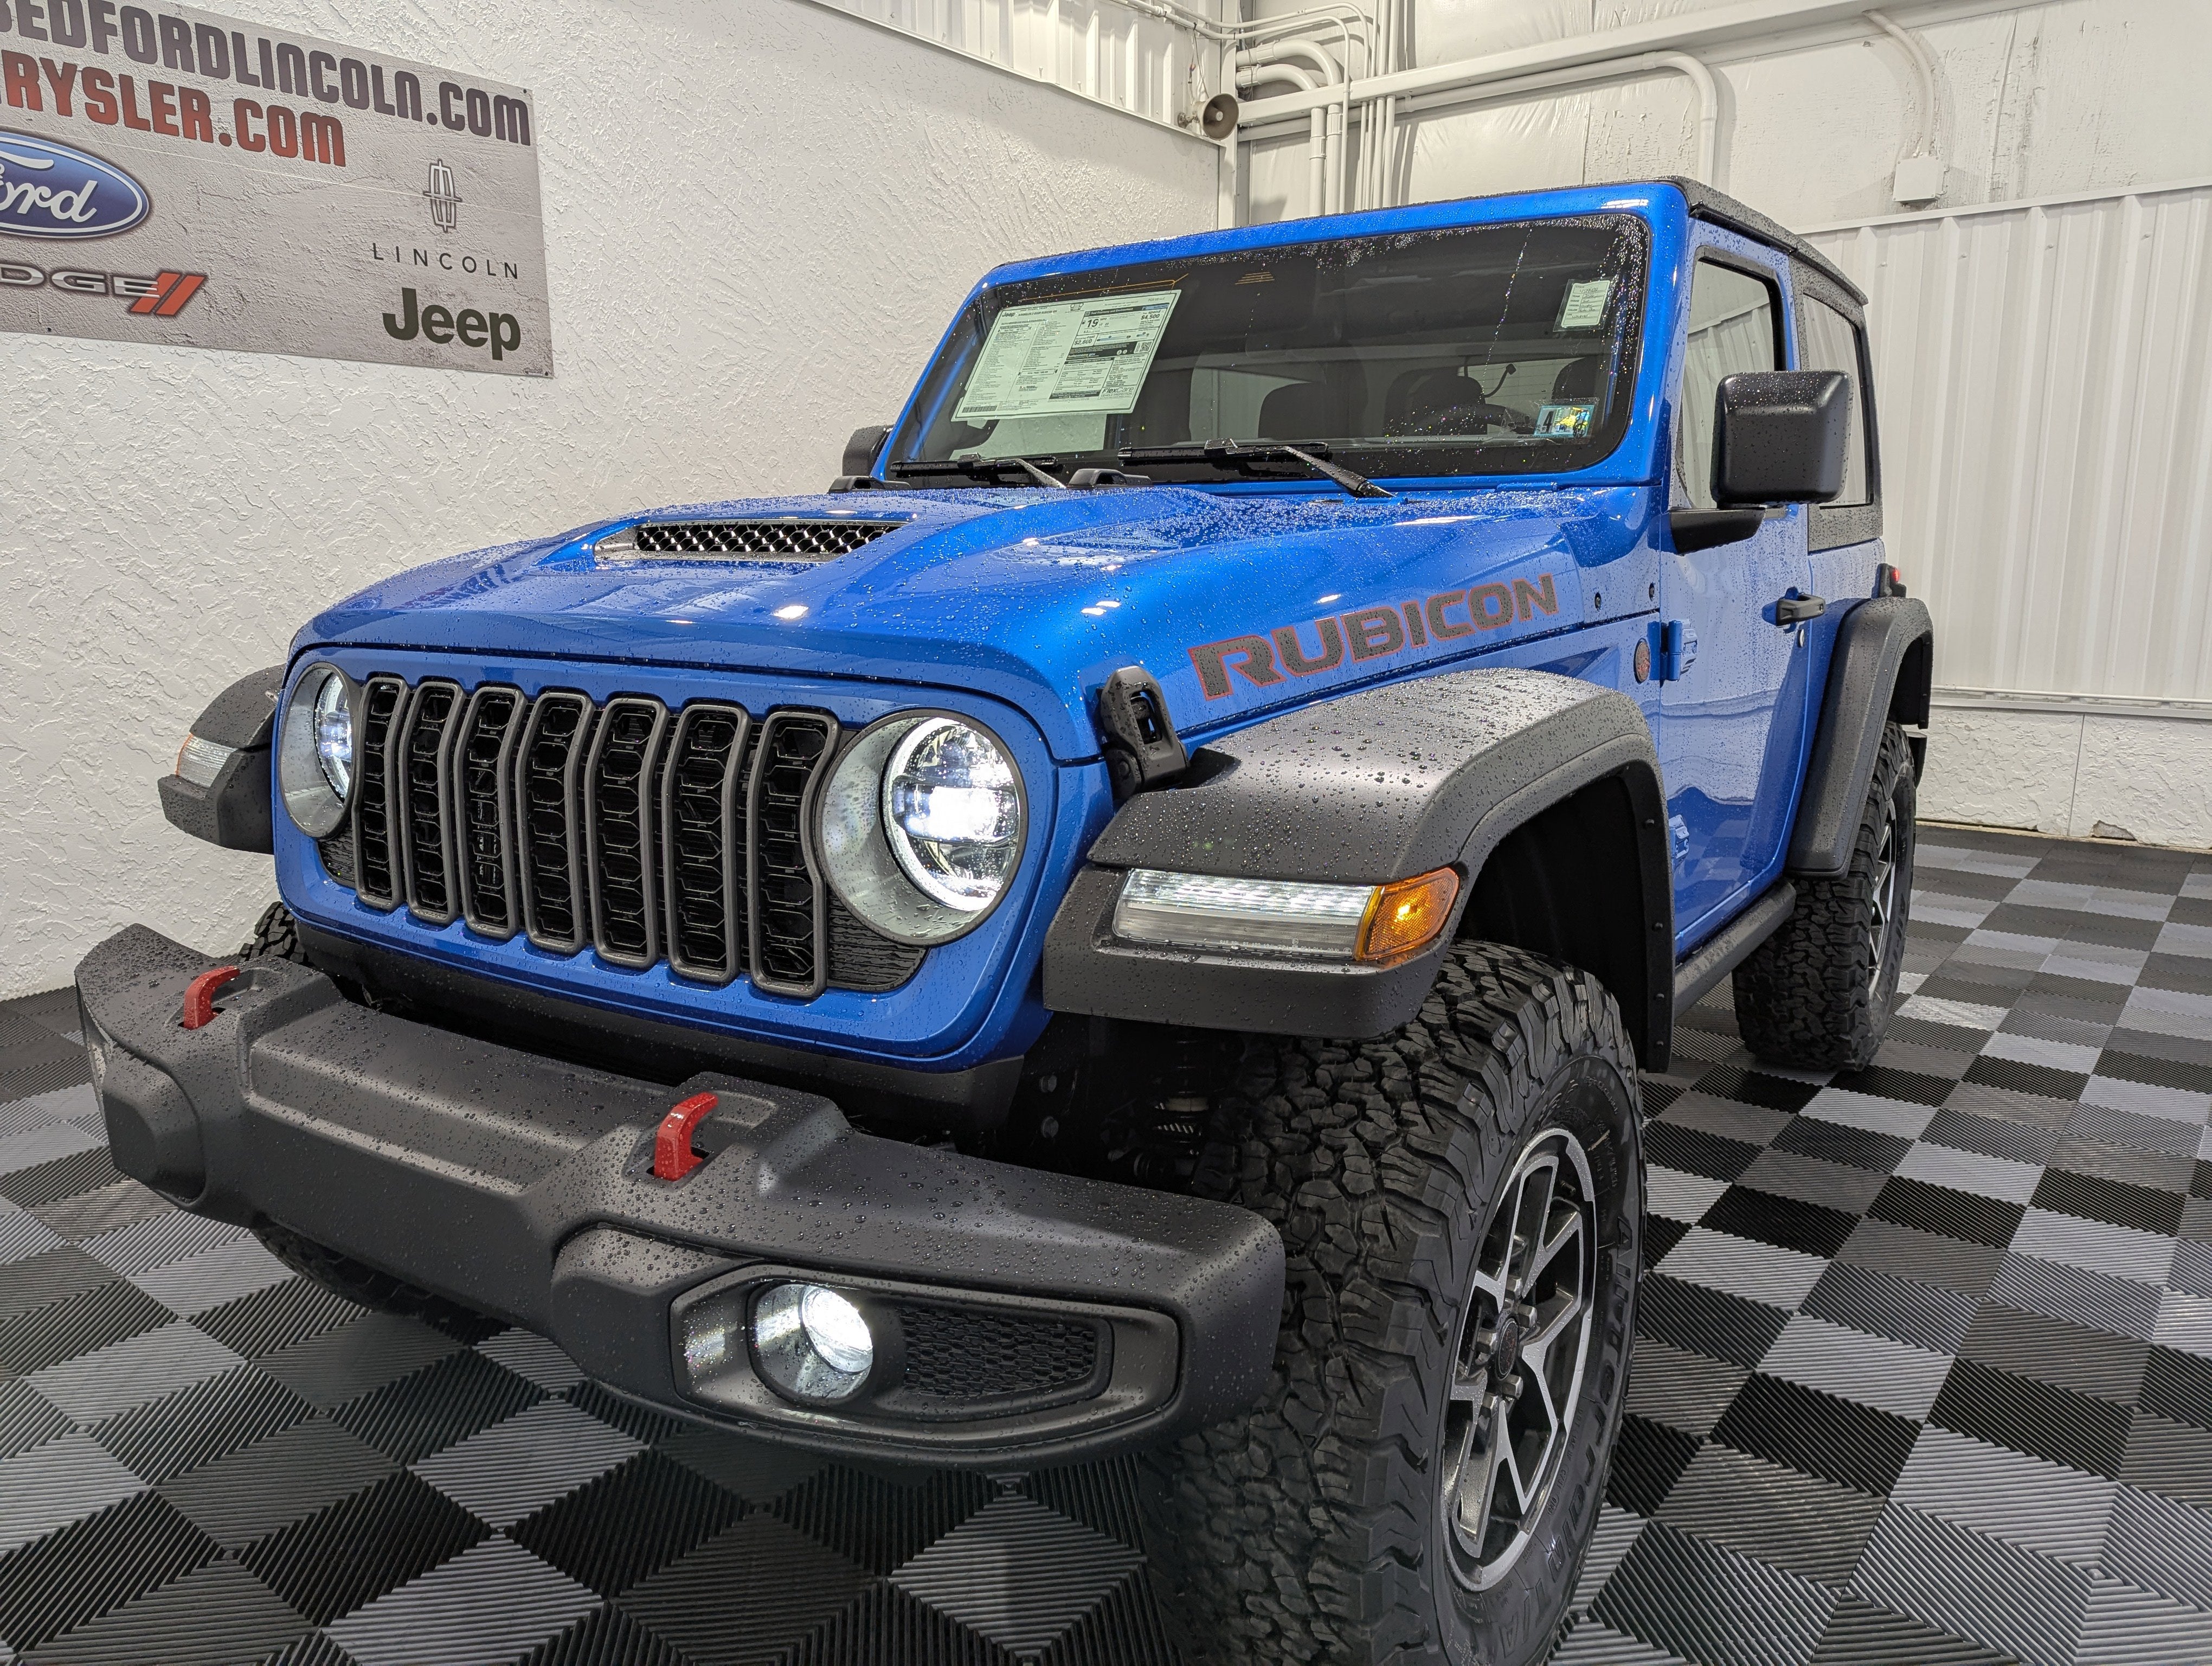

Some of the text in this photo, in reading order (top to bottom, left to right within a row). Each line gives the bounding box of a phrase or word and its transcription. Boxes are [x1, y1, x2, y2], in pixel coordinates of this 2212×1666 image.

[0, 49, 346, 167] RYSLER.COM
[373, 243, 518, 279] LINCOLN
[382, 287, 521, 361] Jeep
[1087, 318, 1098, 328] 19
[1542, 411, 1554, 433] 4
[1187, 573, 1559, 701] RUBICON
